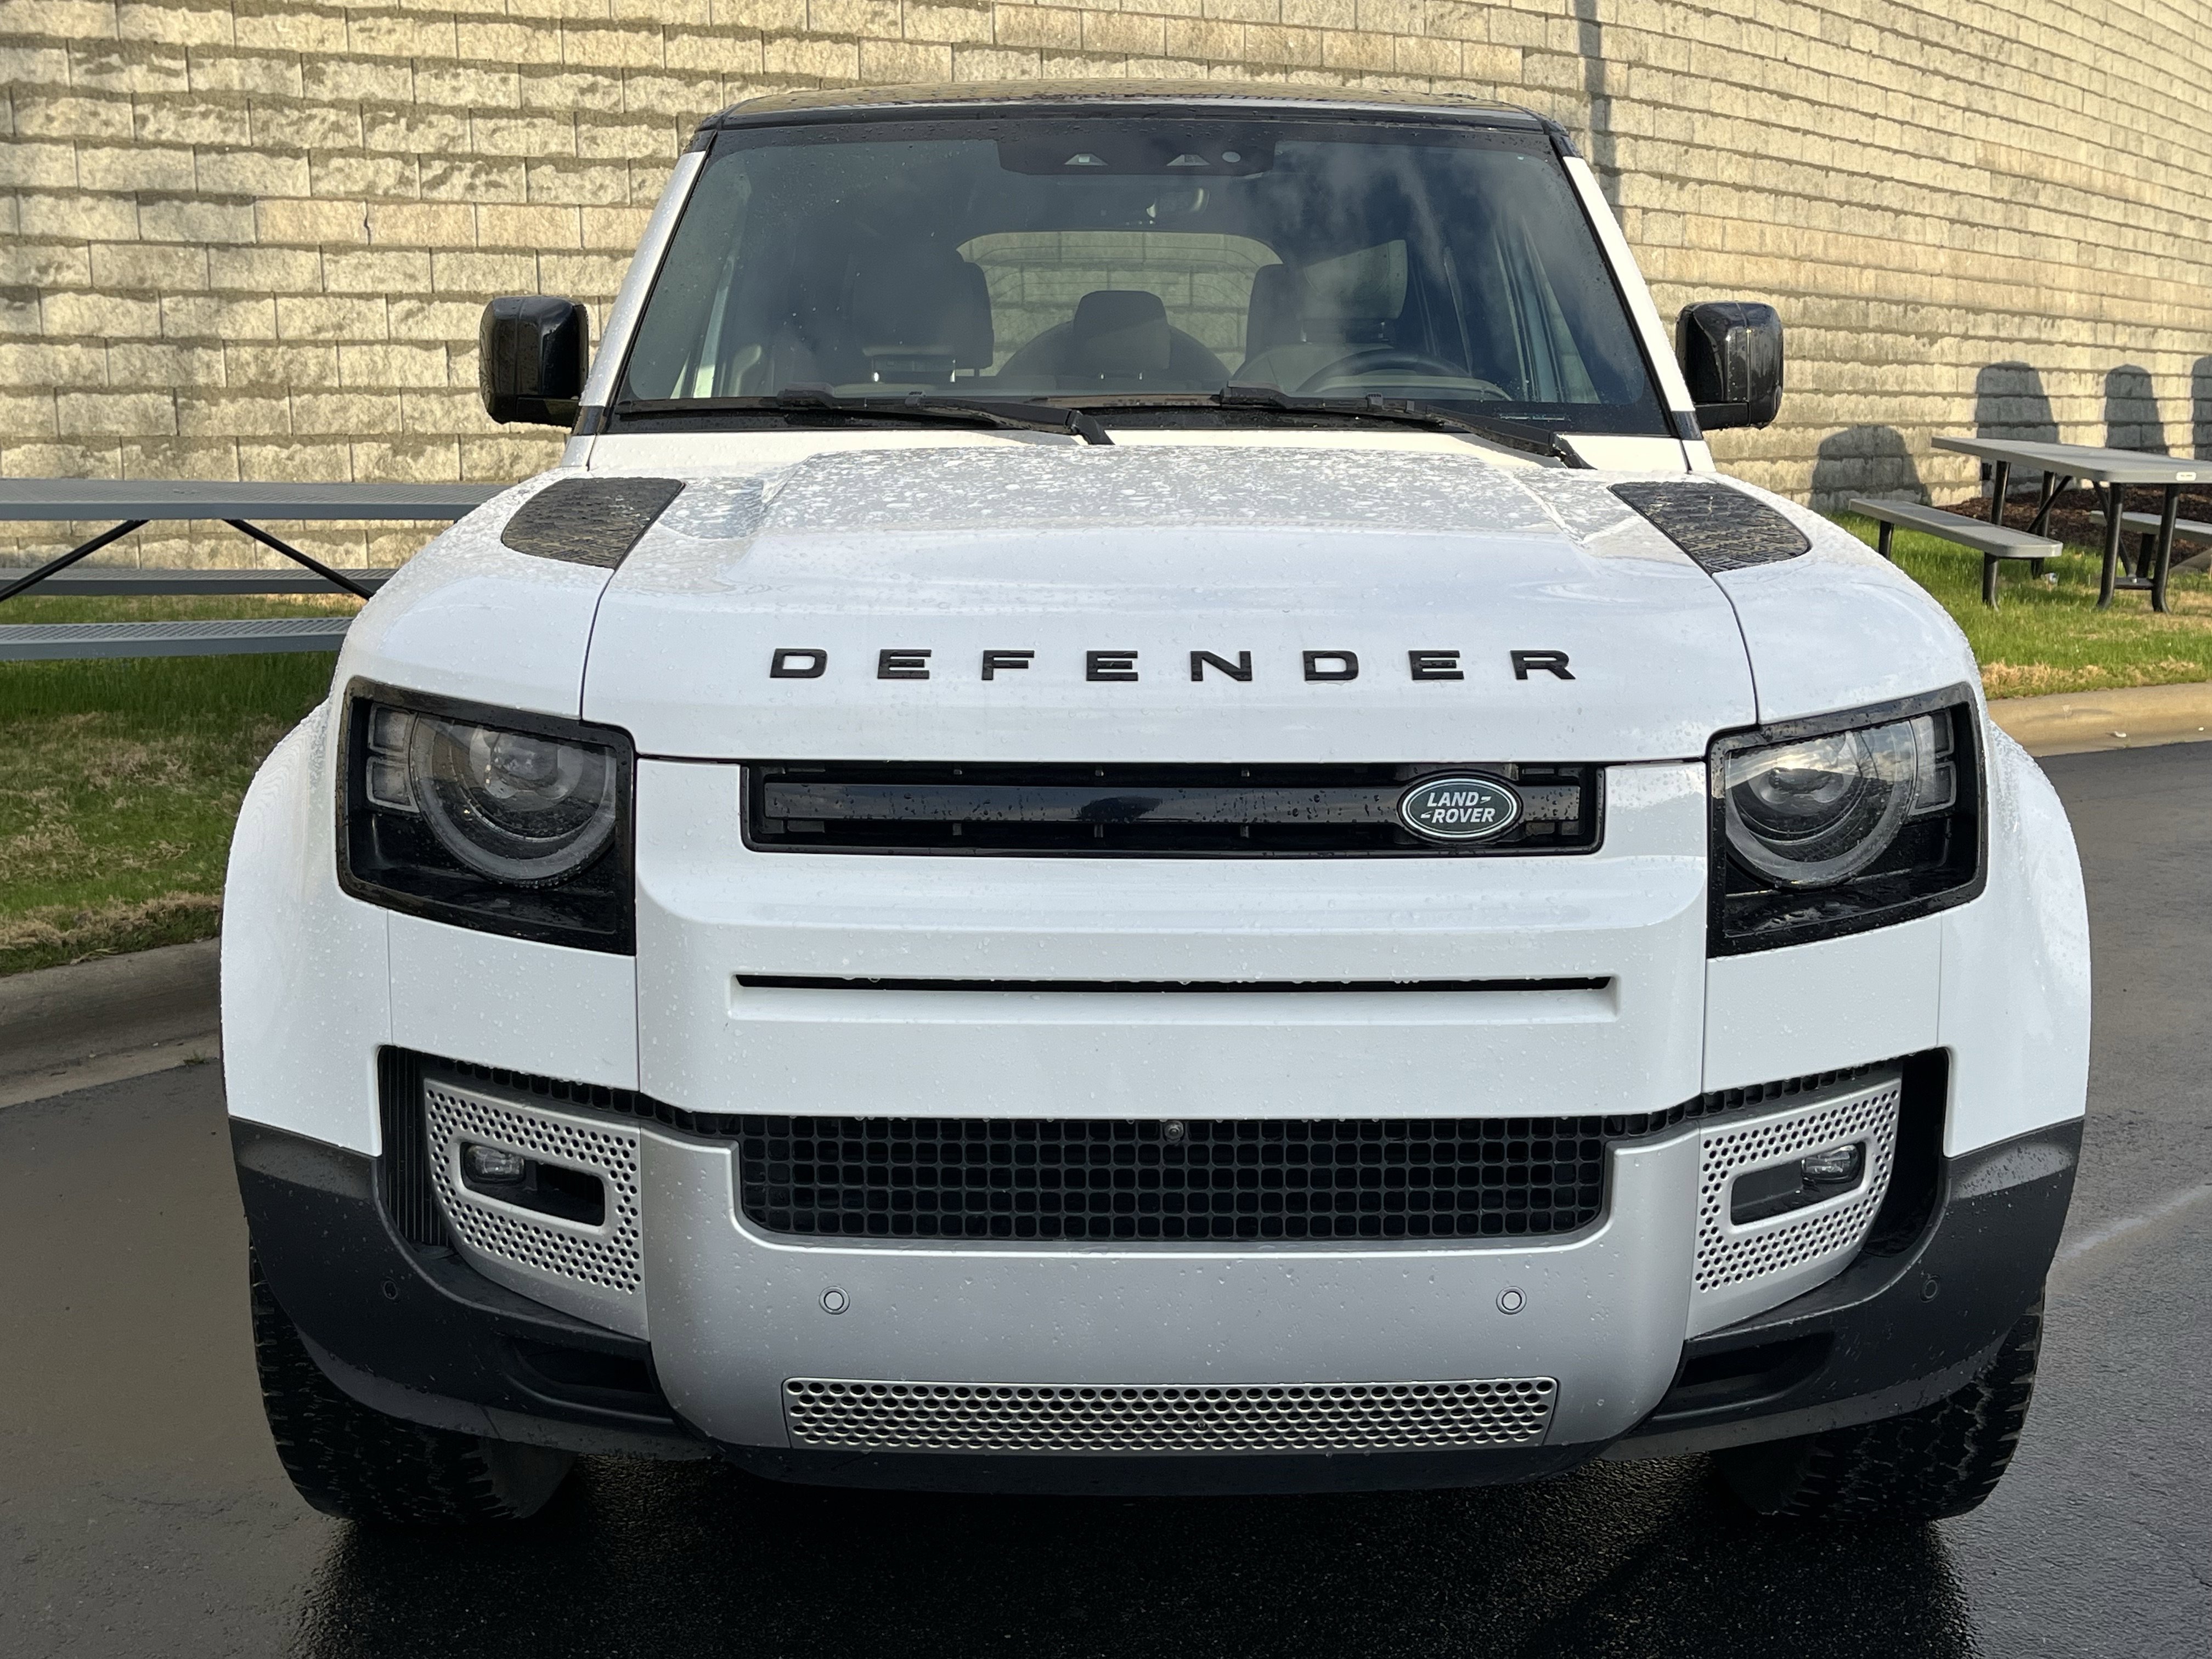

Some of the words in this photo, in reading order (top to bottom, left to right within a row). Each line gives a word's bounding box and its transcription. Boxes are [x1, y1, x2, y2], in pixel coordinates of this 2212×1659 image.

[769, 648, 1576, 681] DEFENDER
[1427, 792, 1479, 806] LAND
[1431, 808, 1496, 823] ROVER
